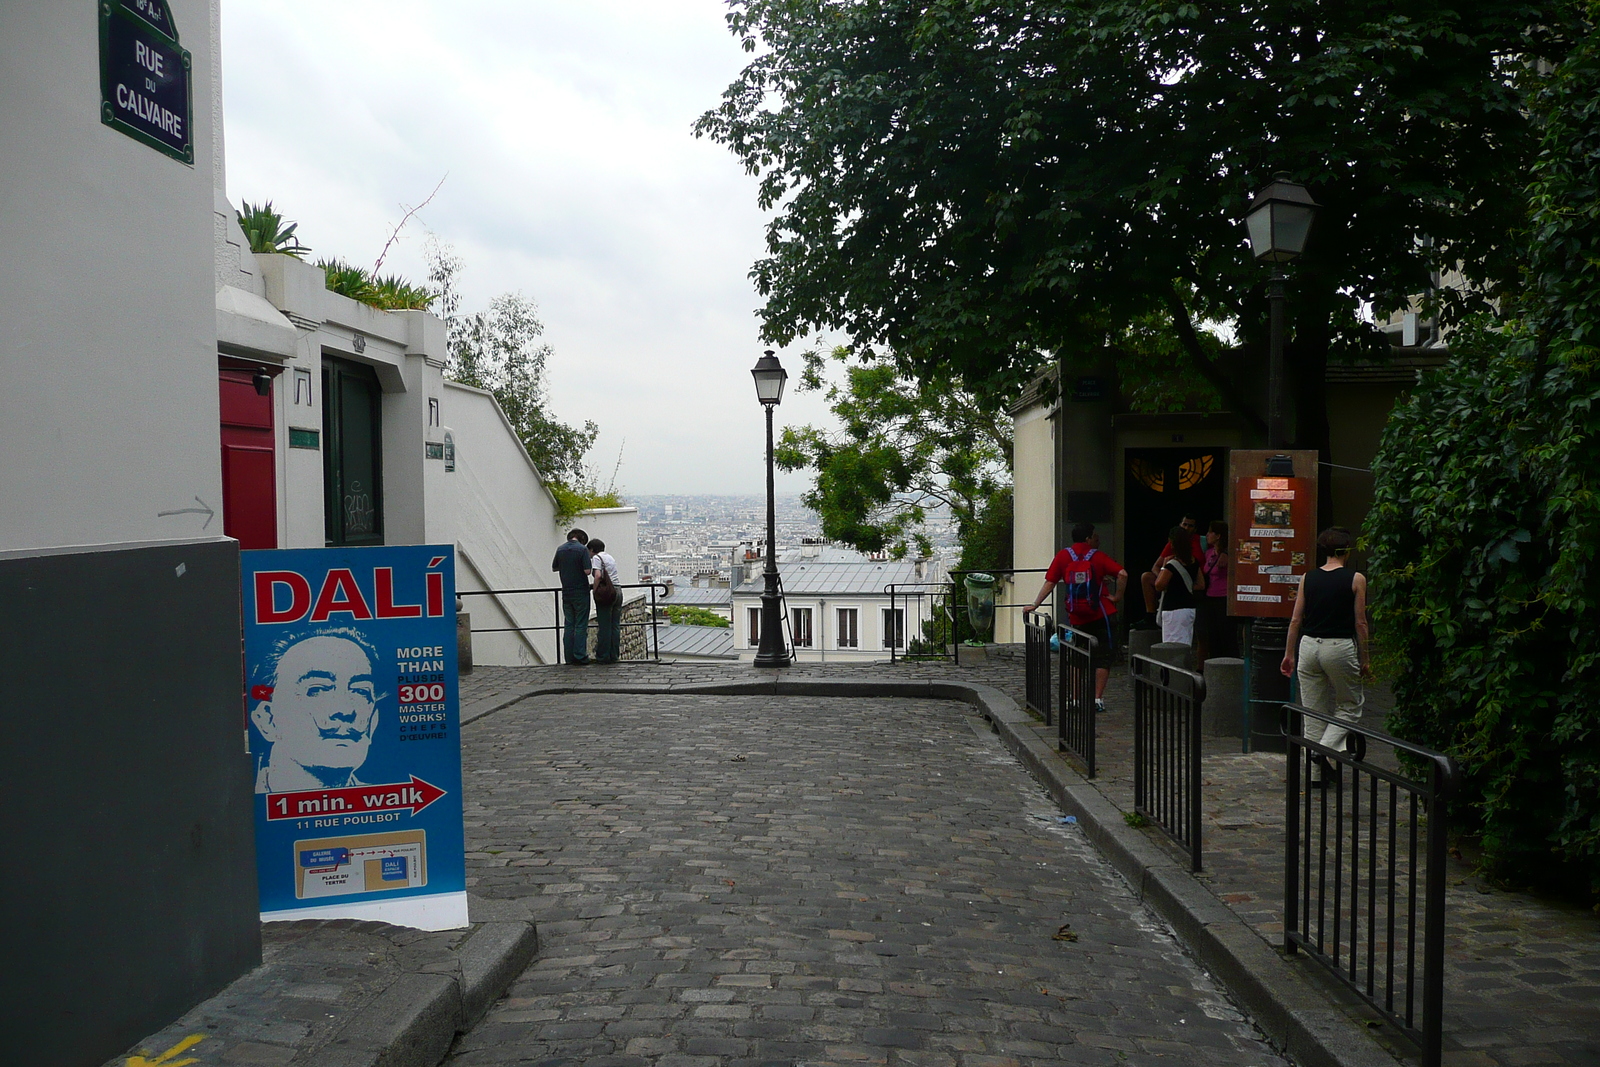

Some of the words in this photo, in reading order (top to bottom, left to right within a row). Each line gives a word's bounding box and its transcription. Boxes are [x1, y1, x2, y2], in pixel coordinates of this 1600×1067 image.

[136, 40, 164, 78] RUE
[145, 77, 156, 93] DU
[116, 83, 182, 139] CALVAIRE
[396, 646, 443, 659] MORE
[397, 660, 444, 673] THAN
[397, 675, 428, 683] PLUS
[430, 674, 444, 682] DE
[400, 684, 444, 702] 300
[399, 703, 445, 713] MASTER
[399, 713, 446, 723] WORKS!
[400, 723, 446, 732] CHEFS
[276, 797, 288, 815] 1
[298, 793, 353, 813] min.
[362, 787, 424, 808] walk
[296, 821, 309, 829] 11
[315, 817, 340, 828] RUE
[343, 812, 401, 825] POULBOT
